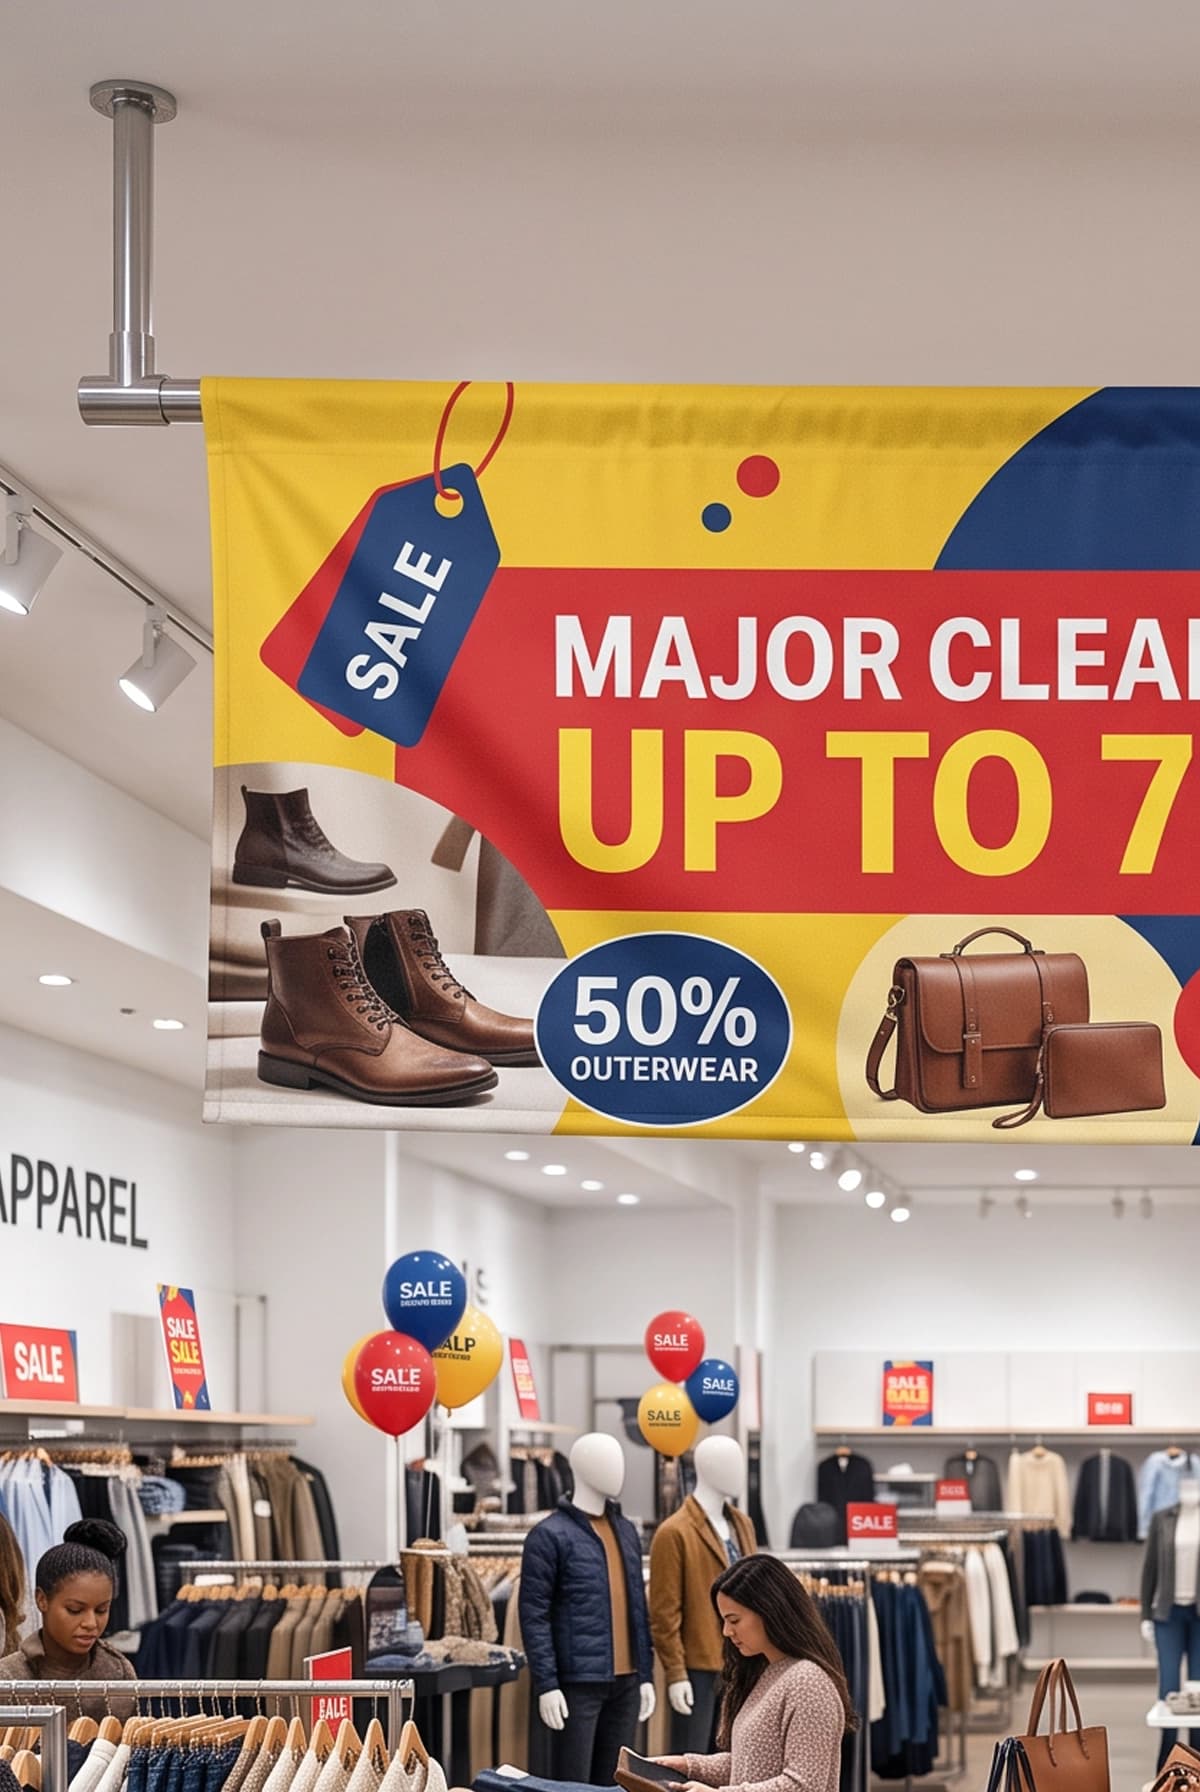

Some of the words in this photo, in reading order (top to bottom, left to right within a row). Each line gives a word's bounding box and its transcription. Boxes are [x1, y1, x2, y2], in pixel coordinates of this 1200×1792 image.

[346, 541, 452, 700] SALE
[554, 615, 902, 701] MAJOR
[558, 728, 783, 874] UP
[826, 729, 1053, 877] TO
[573, 975, 757, 1047] 50%
[570, 1056, 759, 1082] OUTERWEAR
[400, 1281, 452, 1299] SALE
[167, 1316, 196, 1340] SALE
[654, 1334, 689, 1347] SALE
[14, 1341, 65, 1384] SALE
[371, 1368, 421, 1386] SALE
[702, 1377, 735, 1391] SALE
[647, 1410, 681, 1421] SALE
[852, 1515, 893, 1530] SALE
